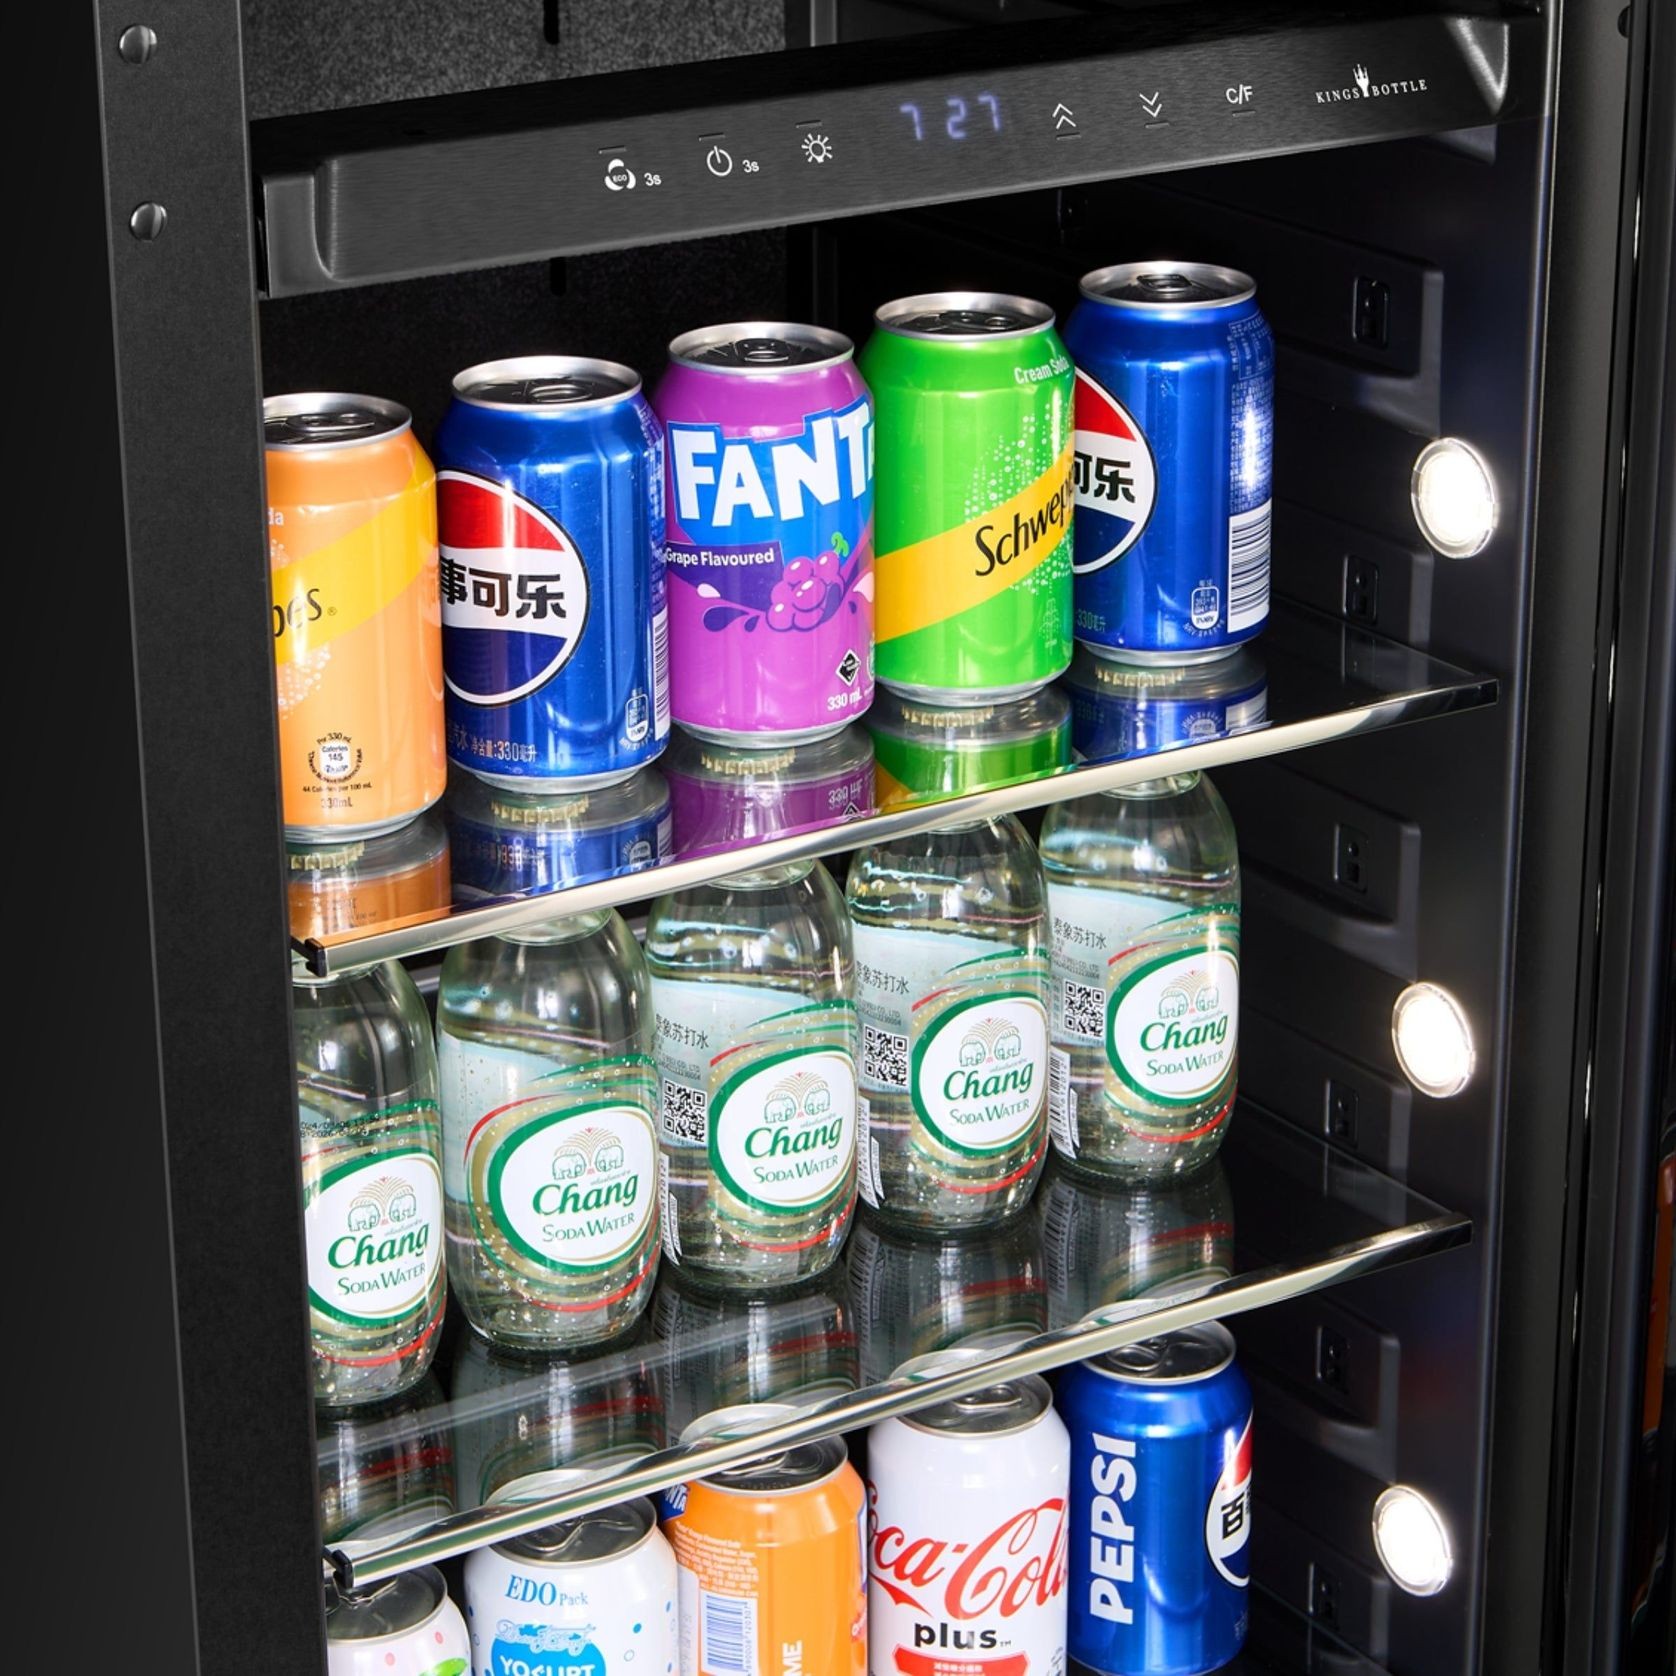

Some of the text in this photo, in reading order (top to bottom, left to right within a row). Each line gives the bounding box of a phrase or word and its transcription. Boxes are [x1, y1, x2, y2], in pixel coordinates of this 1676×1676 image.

[1225, 84, 1254, 105] C/F
[1316, 78, 1428, 104] KINGS BOTTLE
[947, 94, 1000, 140] 27
[643, 173, 662, 186] 3s
[741, 160, 760, 173] 3s
[1014, 365, 1050, 385] Cream
[701, 547, 775, 567] Flavoured
[827, 692, 848, 711] 330
[1140, 1014, 1228, 1052] Chang
[943, 1062, 1034, 1101] Chang
[745, 1117, 843, 1158] Chang
[532, 1174, 639, 1216] Chang
[327, 1223, 430, 1269] Chang
[1090, 1432, 1137, 1625] PEPSI
[505, 1574, 589, 1607] EDO Pack
[914, 1622, 998, 1650] plus
